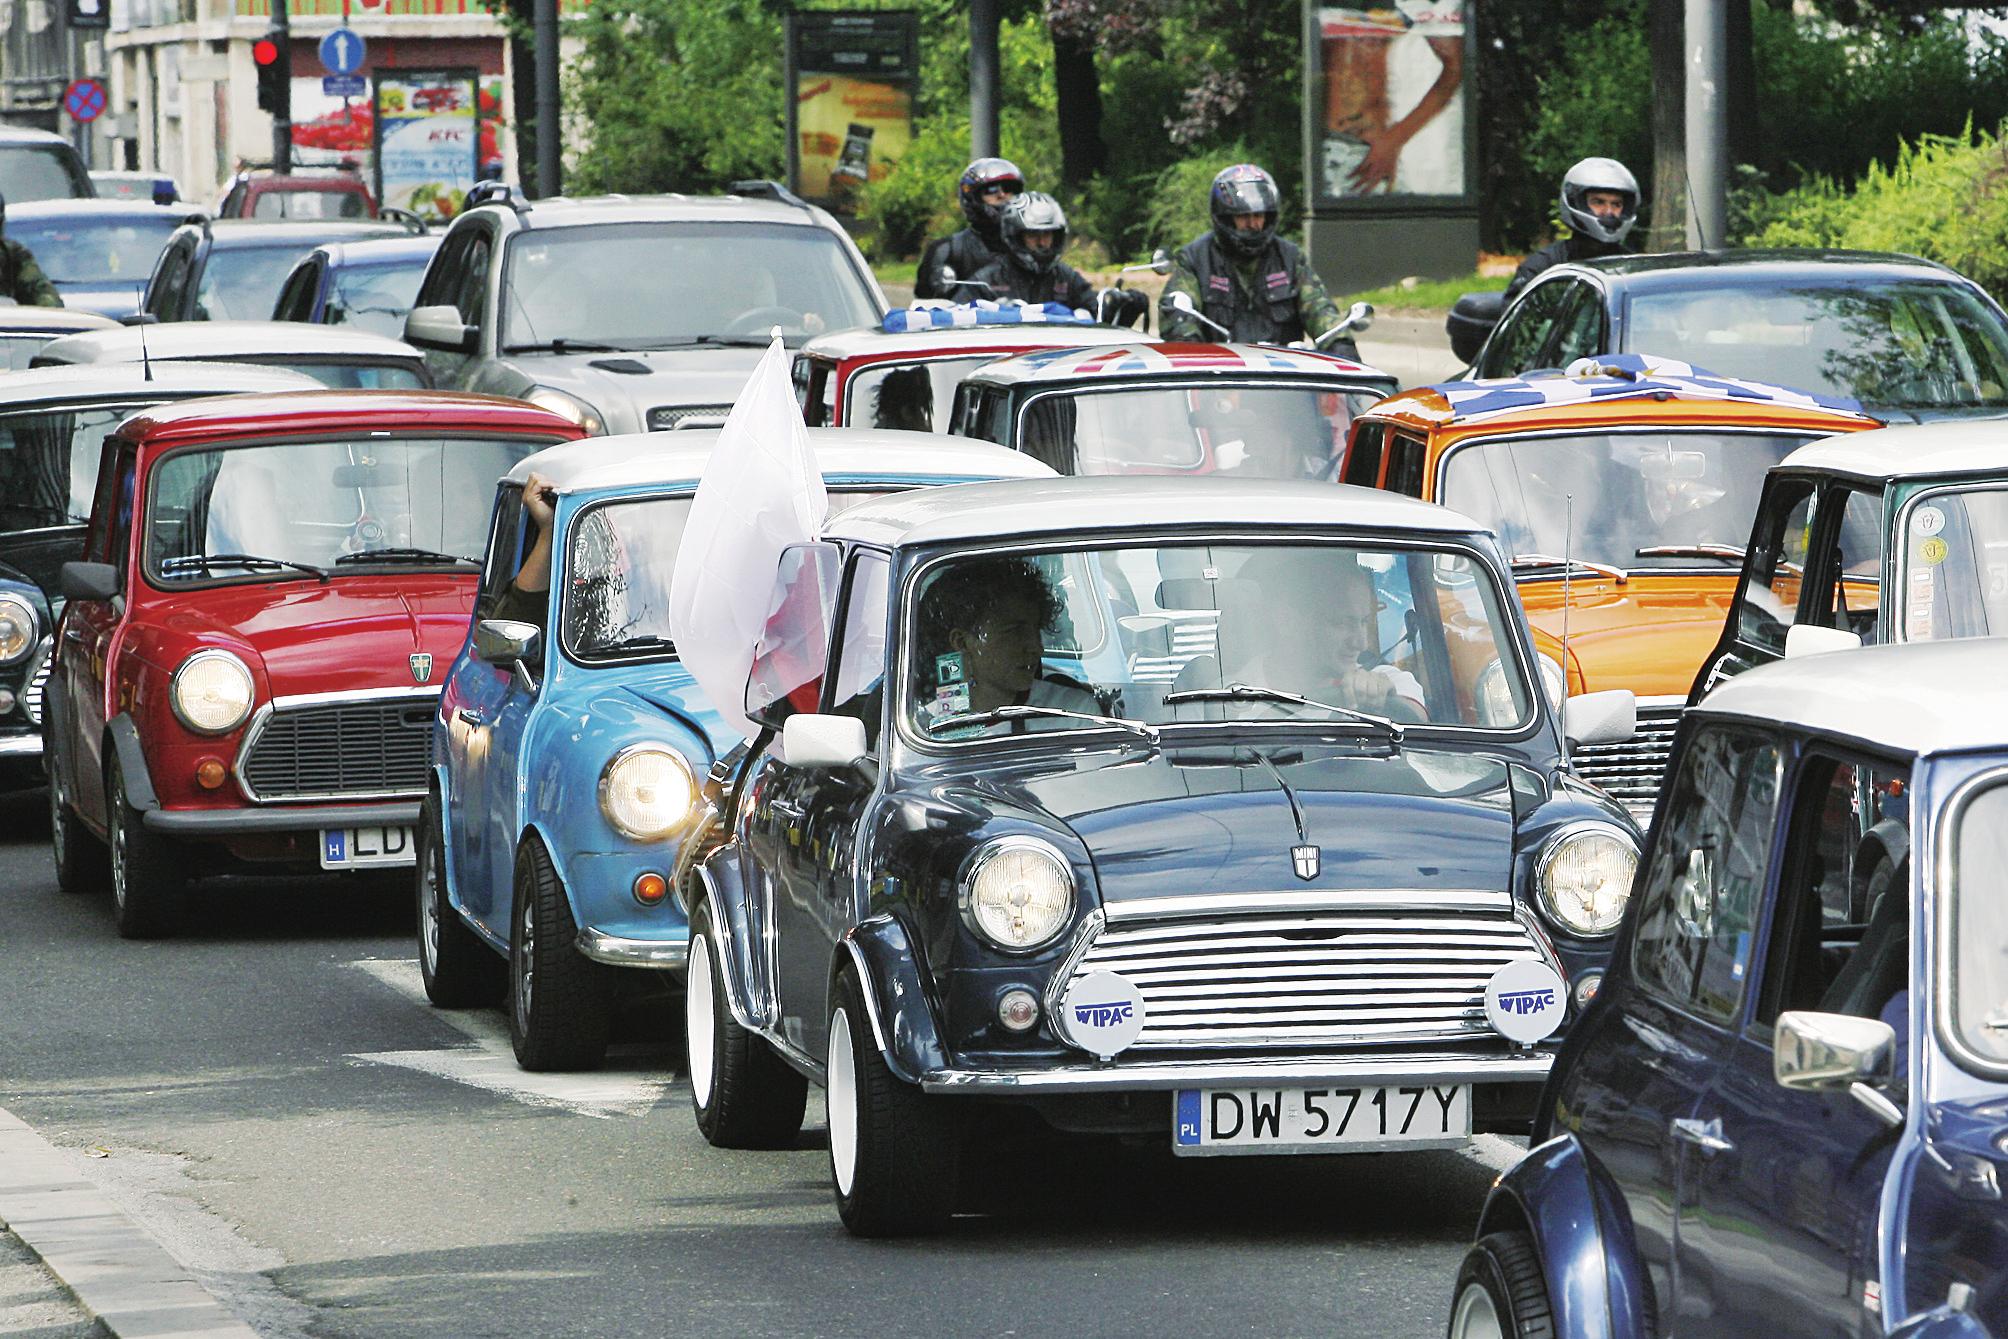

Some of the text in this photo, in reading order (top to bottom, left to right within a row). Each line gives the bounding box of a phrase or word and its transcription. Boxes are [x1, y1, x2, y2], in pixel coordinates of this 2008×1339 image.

[328, 843, 341, 857] H
[352, 826, 417, 857] LD
[1293, 847, 1319, 860] MINI
[1498, 992, 1555, 1015] WIPAC
[1074, 1004, 1134, 1028] WIPAC
[1210, 1085, 1460, 1140] DW 5717Y
[1180, 1123, 1199, 1137] PL
